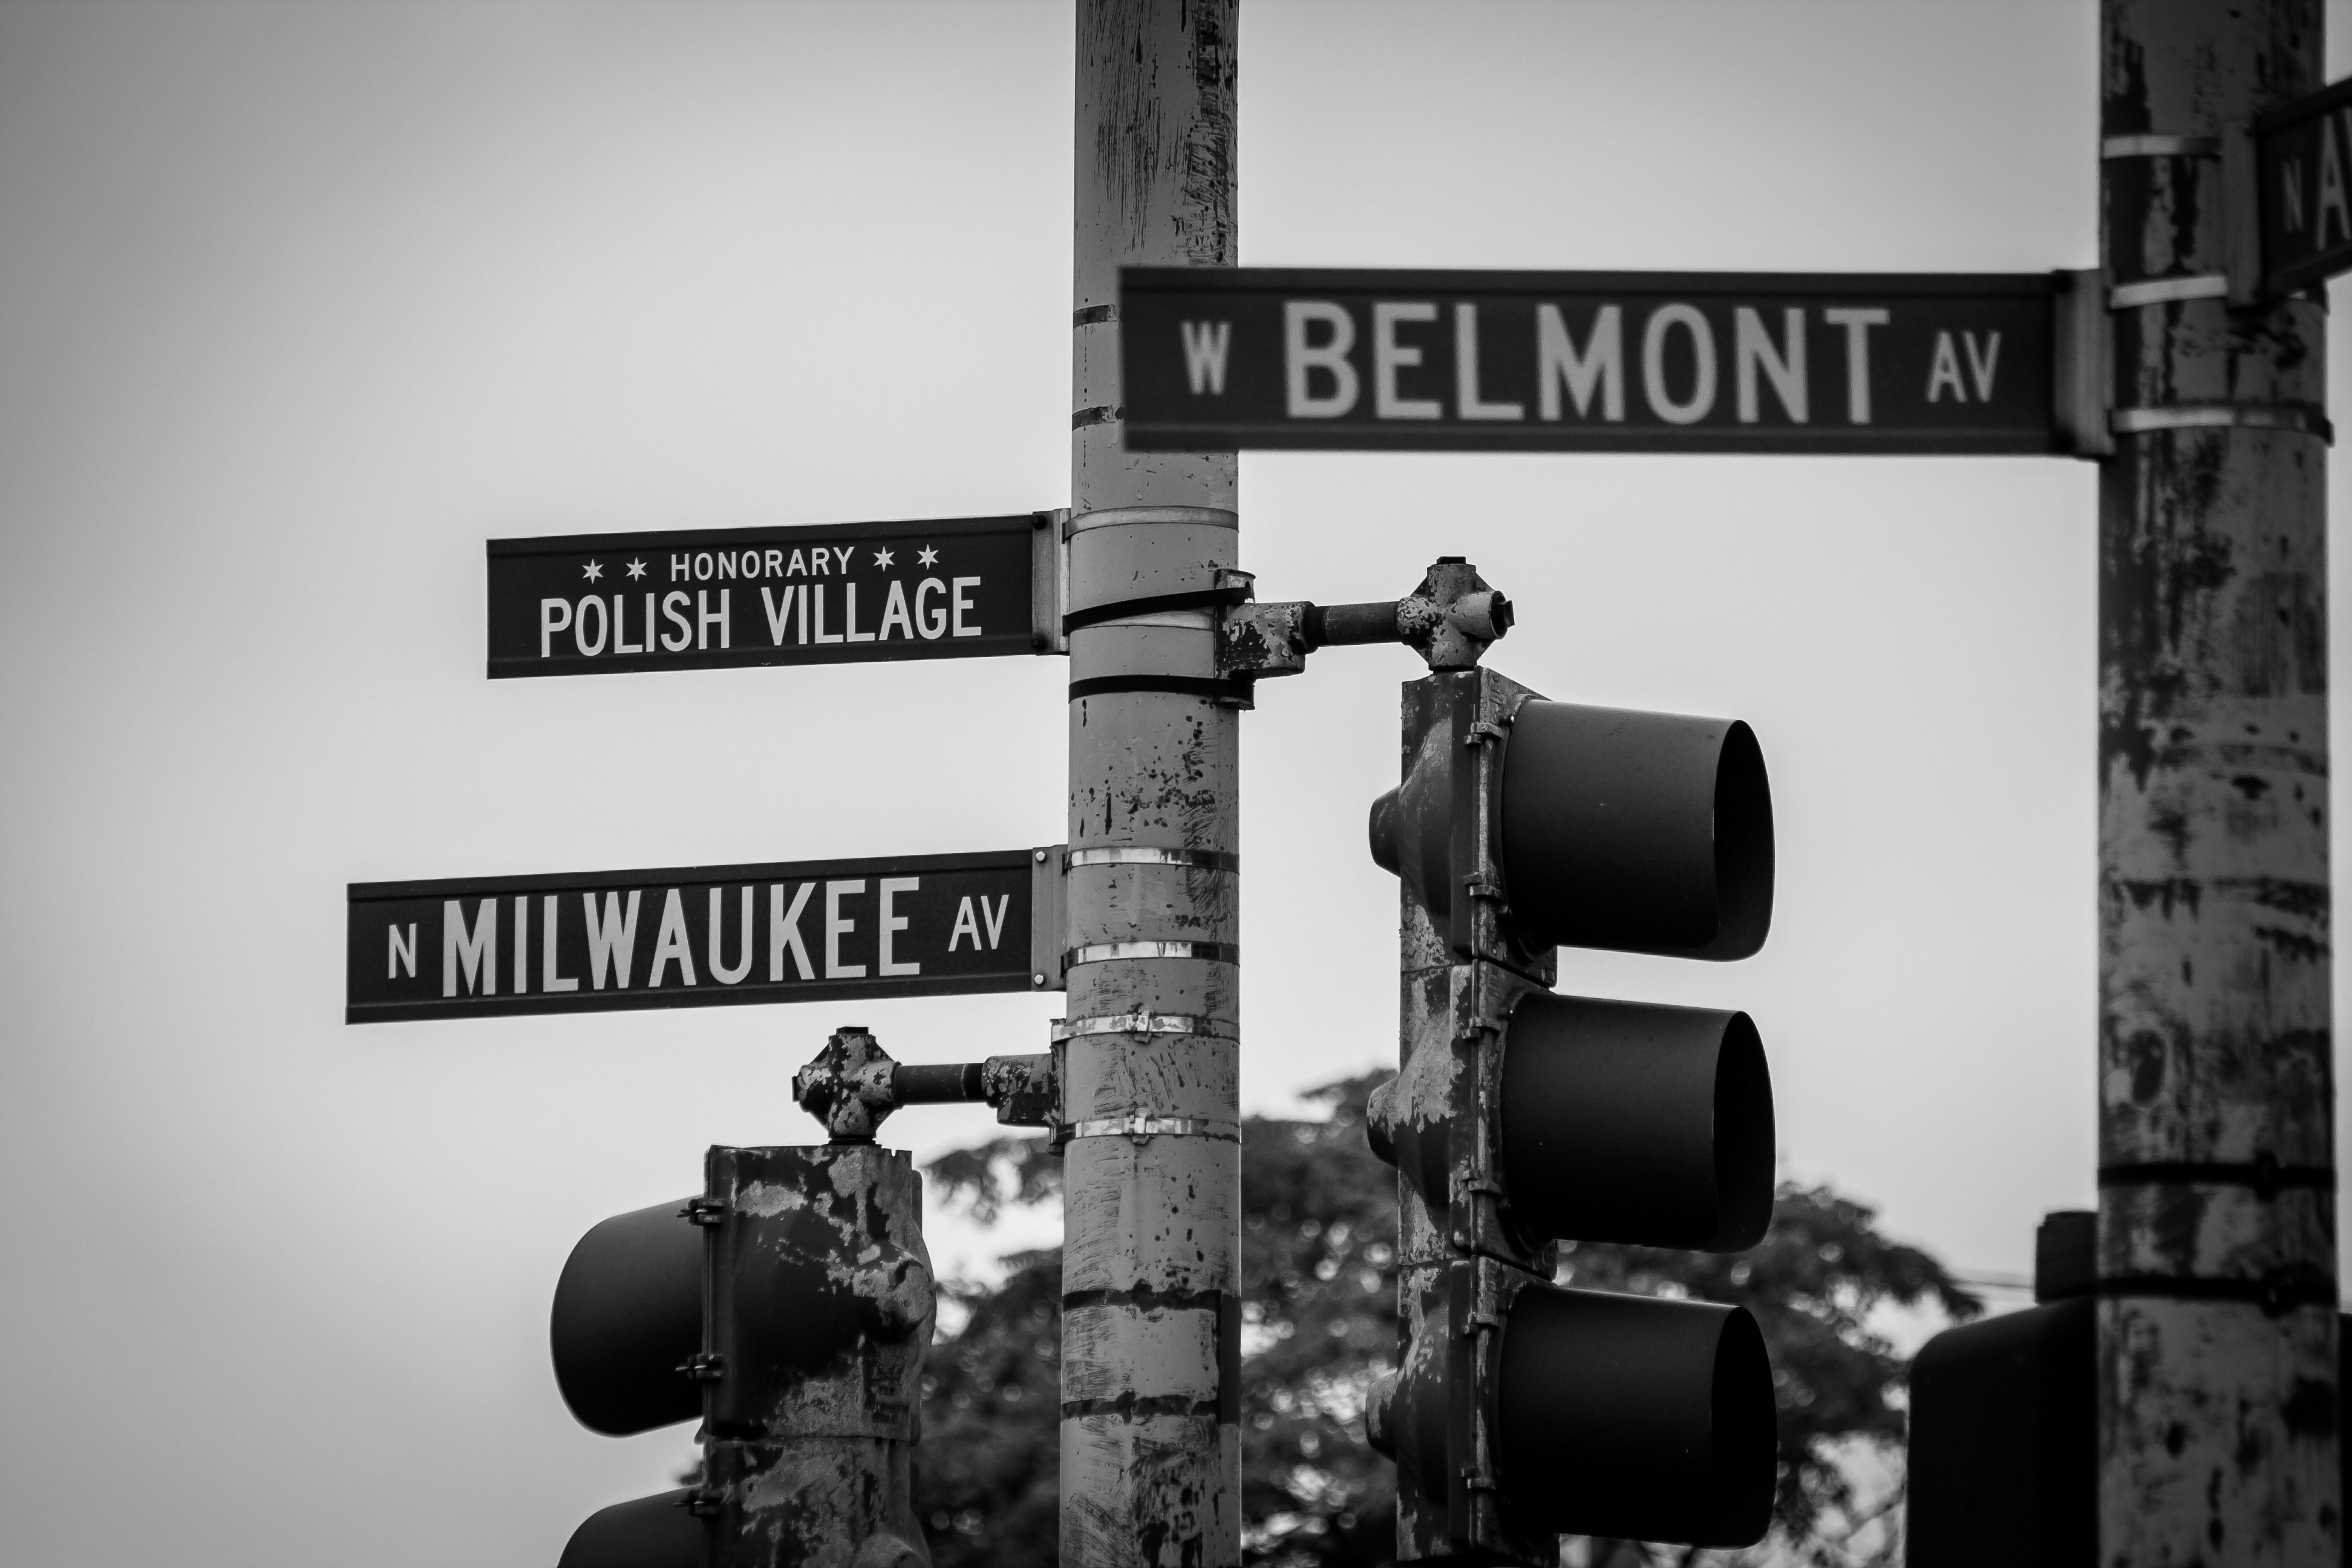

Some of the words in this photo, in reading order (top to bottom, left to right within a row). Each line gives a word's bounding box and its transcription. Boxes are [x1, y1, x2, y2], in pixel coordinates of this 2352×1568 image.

[1180, 321, 1231, 395] W
[1284, 299, 1889, 426] BELMONT
[1926, 330, 2001, 403] AV
[670, 546, 855, 583] HONORARY
[540, 588, 730, 659] POLISH
[760, 575, 982, 647] VILLAGE
[388, 922, 417, 979] N
[442, 876, 921, 998] MILWAUKEE
[947, 893, 1010, 953] AV
